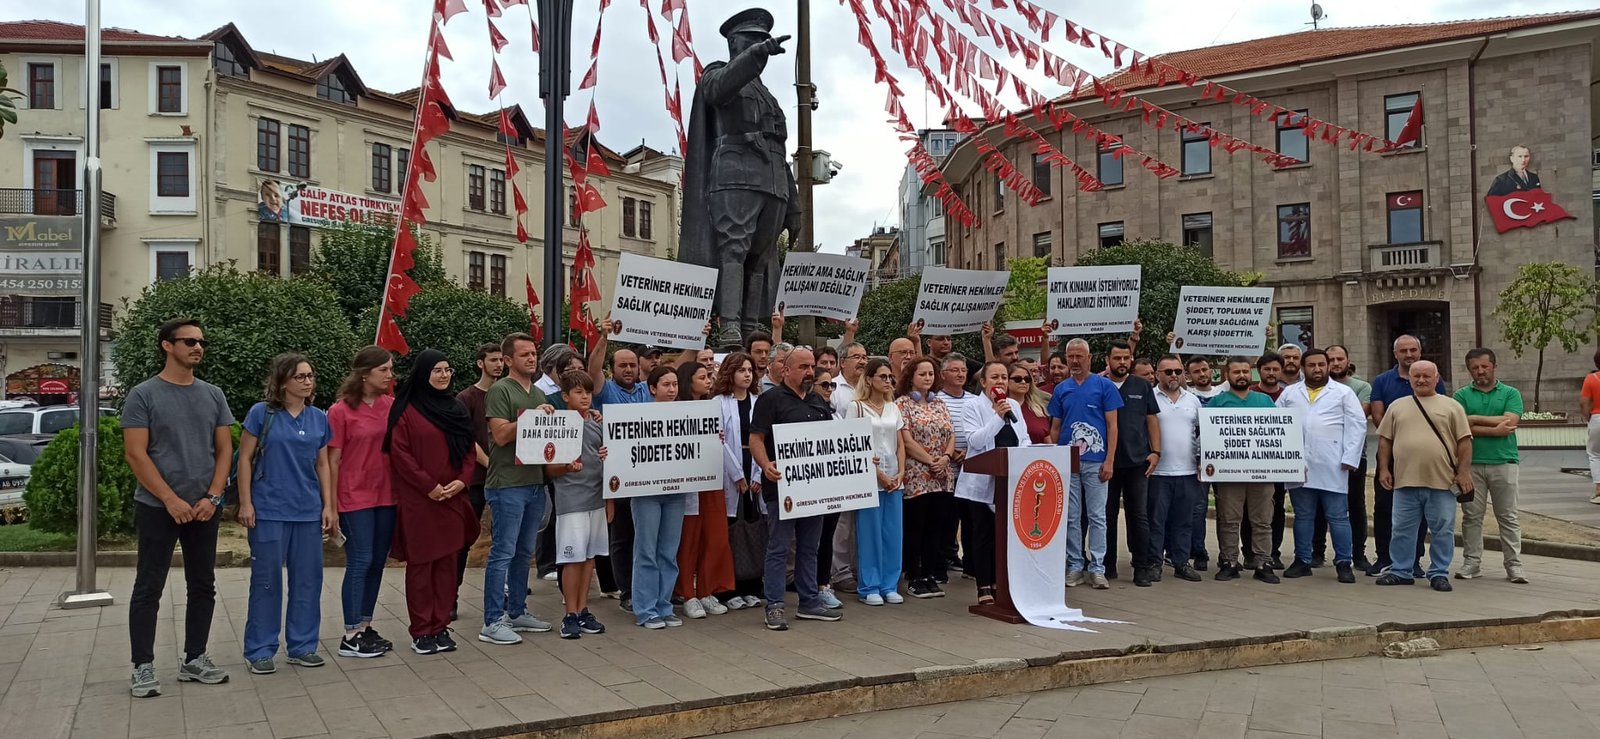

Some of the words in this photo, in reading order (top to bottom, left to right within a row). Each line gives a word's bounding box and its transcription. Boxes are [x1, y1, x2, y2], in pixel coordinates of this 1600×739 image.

[300, 187, 327, 200] GALİP
[330, 194, 357, 206] ATLAS
[301, 200, 346, 222] NEFES
[4, 222, 72, 240] Mabel
[0, 255, 82, 270] İRALI
[783, 262, 816, 277] HEKİMİZ
[816, 266, 832, 278] AMA
[834, 267, 866, 283] SAĞLIK
[28, 280, 54, 288] 250
[56, 280, 68, 288] 51
[621, 274, 671, 294] VETERİNER
[673, 282, 714, 300] HEKİMLER
[784, 280, 819, 294] ÇALIŞANI
[819, 281, 852, 296] DEĞİLİZ
[852, 286, 856, 297] !
[924, 283, 967, 296] VETERİNER
[968, 285, 1005, 296] HEKİMLER
[1050, 281, 1068, 294] ARTIK
[1070, 280, 1097, 293] KINAMAK
[1098, 277, 1139, 292] İSTEMİYORUZ,
[920, 299, 950, 312] SAĞLIK
[951, 302, 995, 314] ÇALIŞANIDIR
[1057, 296, 1095, 309] HAKLARIMIZI
[1097, 294, 1128, 308] İSTİYORUZ
[1128, 296, 1132, 306] !
[1183, 294, 1226, 302] VETERİNER
[1226, 295, 1270, 304] HEKİMLERE
[617, 296, 652, 313] SAĞLIK
[654, 302, 706, 320] ÇALIŞANIDIR
[1186, 306, 1214, 315] ŞİDDET,
[1219, 318, 1259, 326] SAĞLIĞINA
[626, 328, 649, 336] GİRESUN
[650, 329, 677, 338] VETERİNER
[1187, 329, 1212, 337] KARŞI
[1212, 329, 1254, 338] ŞİDDETTİR.
[1210, 414, 1252, 424] VETERİNER
[1254, 414, 1293, 424] HEKİMLER
[522, 429, 542, 438] DAHA
[544, 427, 578, 440] GÜÇLÜYÜZ
[608, 417, 664, 440] VETERİNER
[666, 415, 720, 437] HEKİMLERE
[1220, 426, 1246, 436] ACİLEN
[1248, 426, 1286, 436] SAĞLIKTA
[778, 438, 814, 460] HEKİMİZ
[816, 438, 836, 456] AMA
[837, 434, 872, 454] SAĞLIK
[1224, 438, 1251, 450] ŞİDDET
[1255, 439, 1282, 448] YASASI
[631, 442, 672, 468] ŞİDDETE
[675, 442, 694, 460] SON
[697, 442, 700, 459] !
[1204, 450, 1250, 460] KAPSAMINA
[1252, 450, 1302, 460] ALINMALIDIR.
[785, 462, 825, 486] ÇALIŞANI
[827, 455, 864, 478] DEĞİLİZ
[864, 458, 868, 472] !
